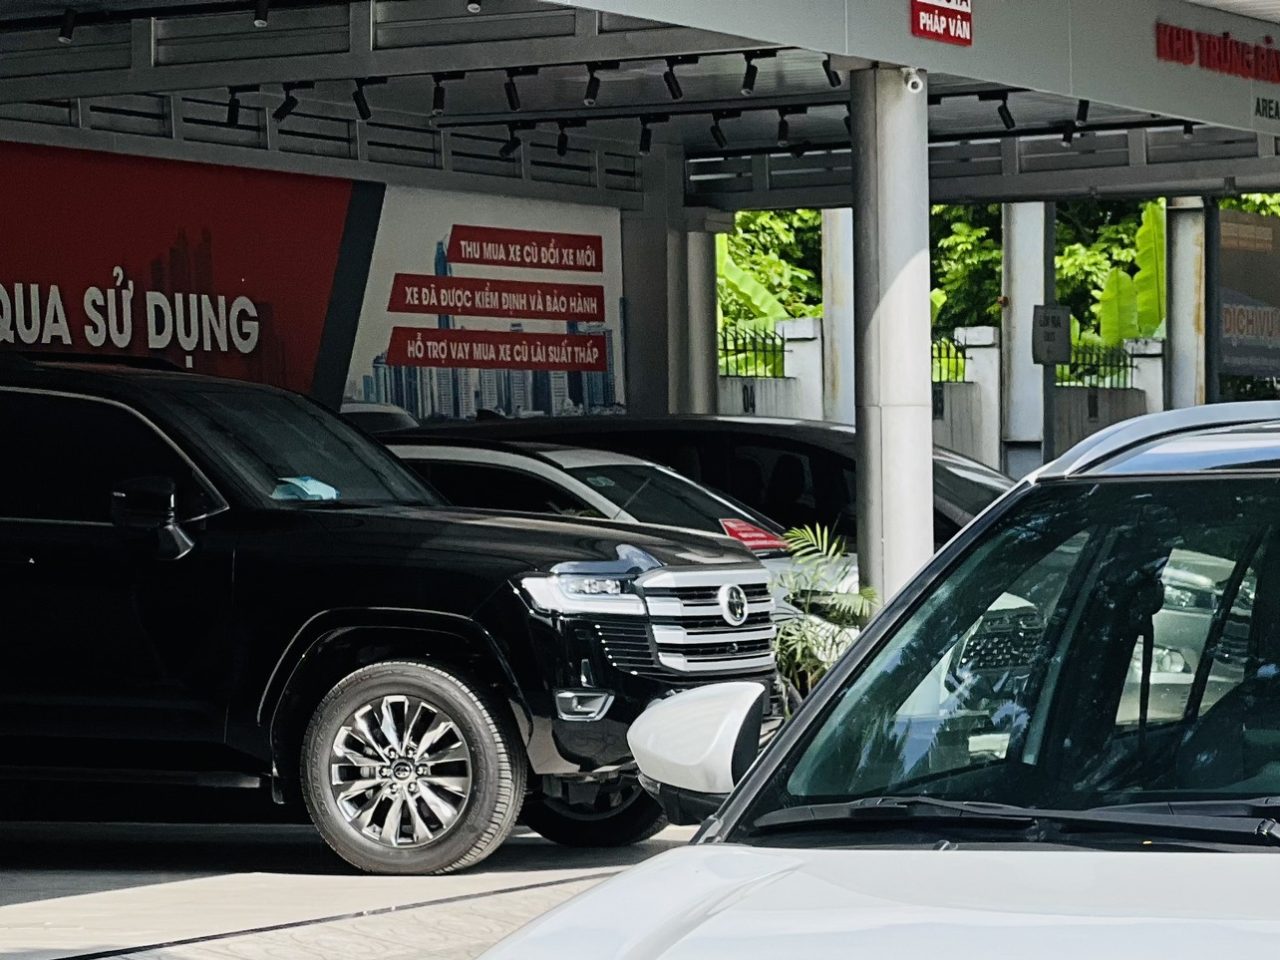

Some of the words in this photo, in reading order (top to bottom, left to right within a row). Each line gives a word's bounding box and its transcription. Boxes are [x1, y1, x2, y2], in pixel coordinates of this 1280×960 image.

[919, 10, 947, 35] PHÁP
[948, 15, 971, 40] VÂN
[1255, 97, 1280, 120] AREA
[460, 241, 480, 259] THU
[482, 242, 505, 260] MUA
[508, 244, 521, 262] XE
[523, 242, 538, 263] CŨ
[562, 249, 574, 267] XE
[576, 246, 596, 267] MỚI
[405, 286, 420, 305] XE
[528, 289, 544, 312] VÀ
[569, 292, 598, 315] HÀNH
[84, 266, 134, 348] SỬ
[146, 291, 259, 368] DỤNG
[449, 341, 471, 359] VAY
[473, 342, 496, 360] MUA
[498, 344, 511, 362] XE
